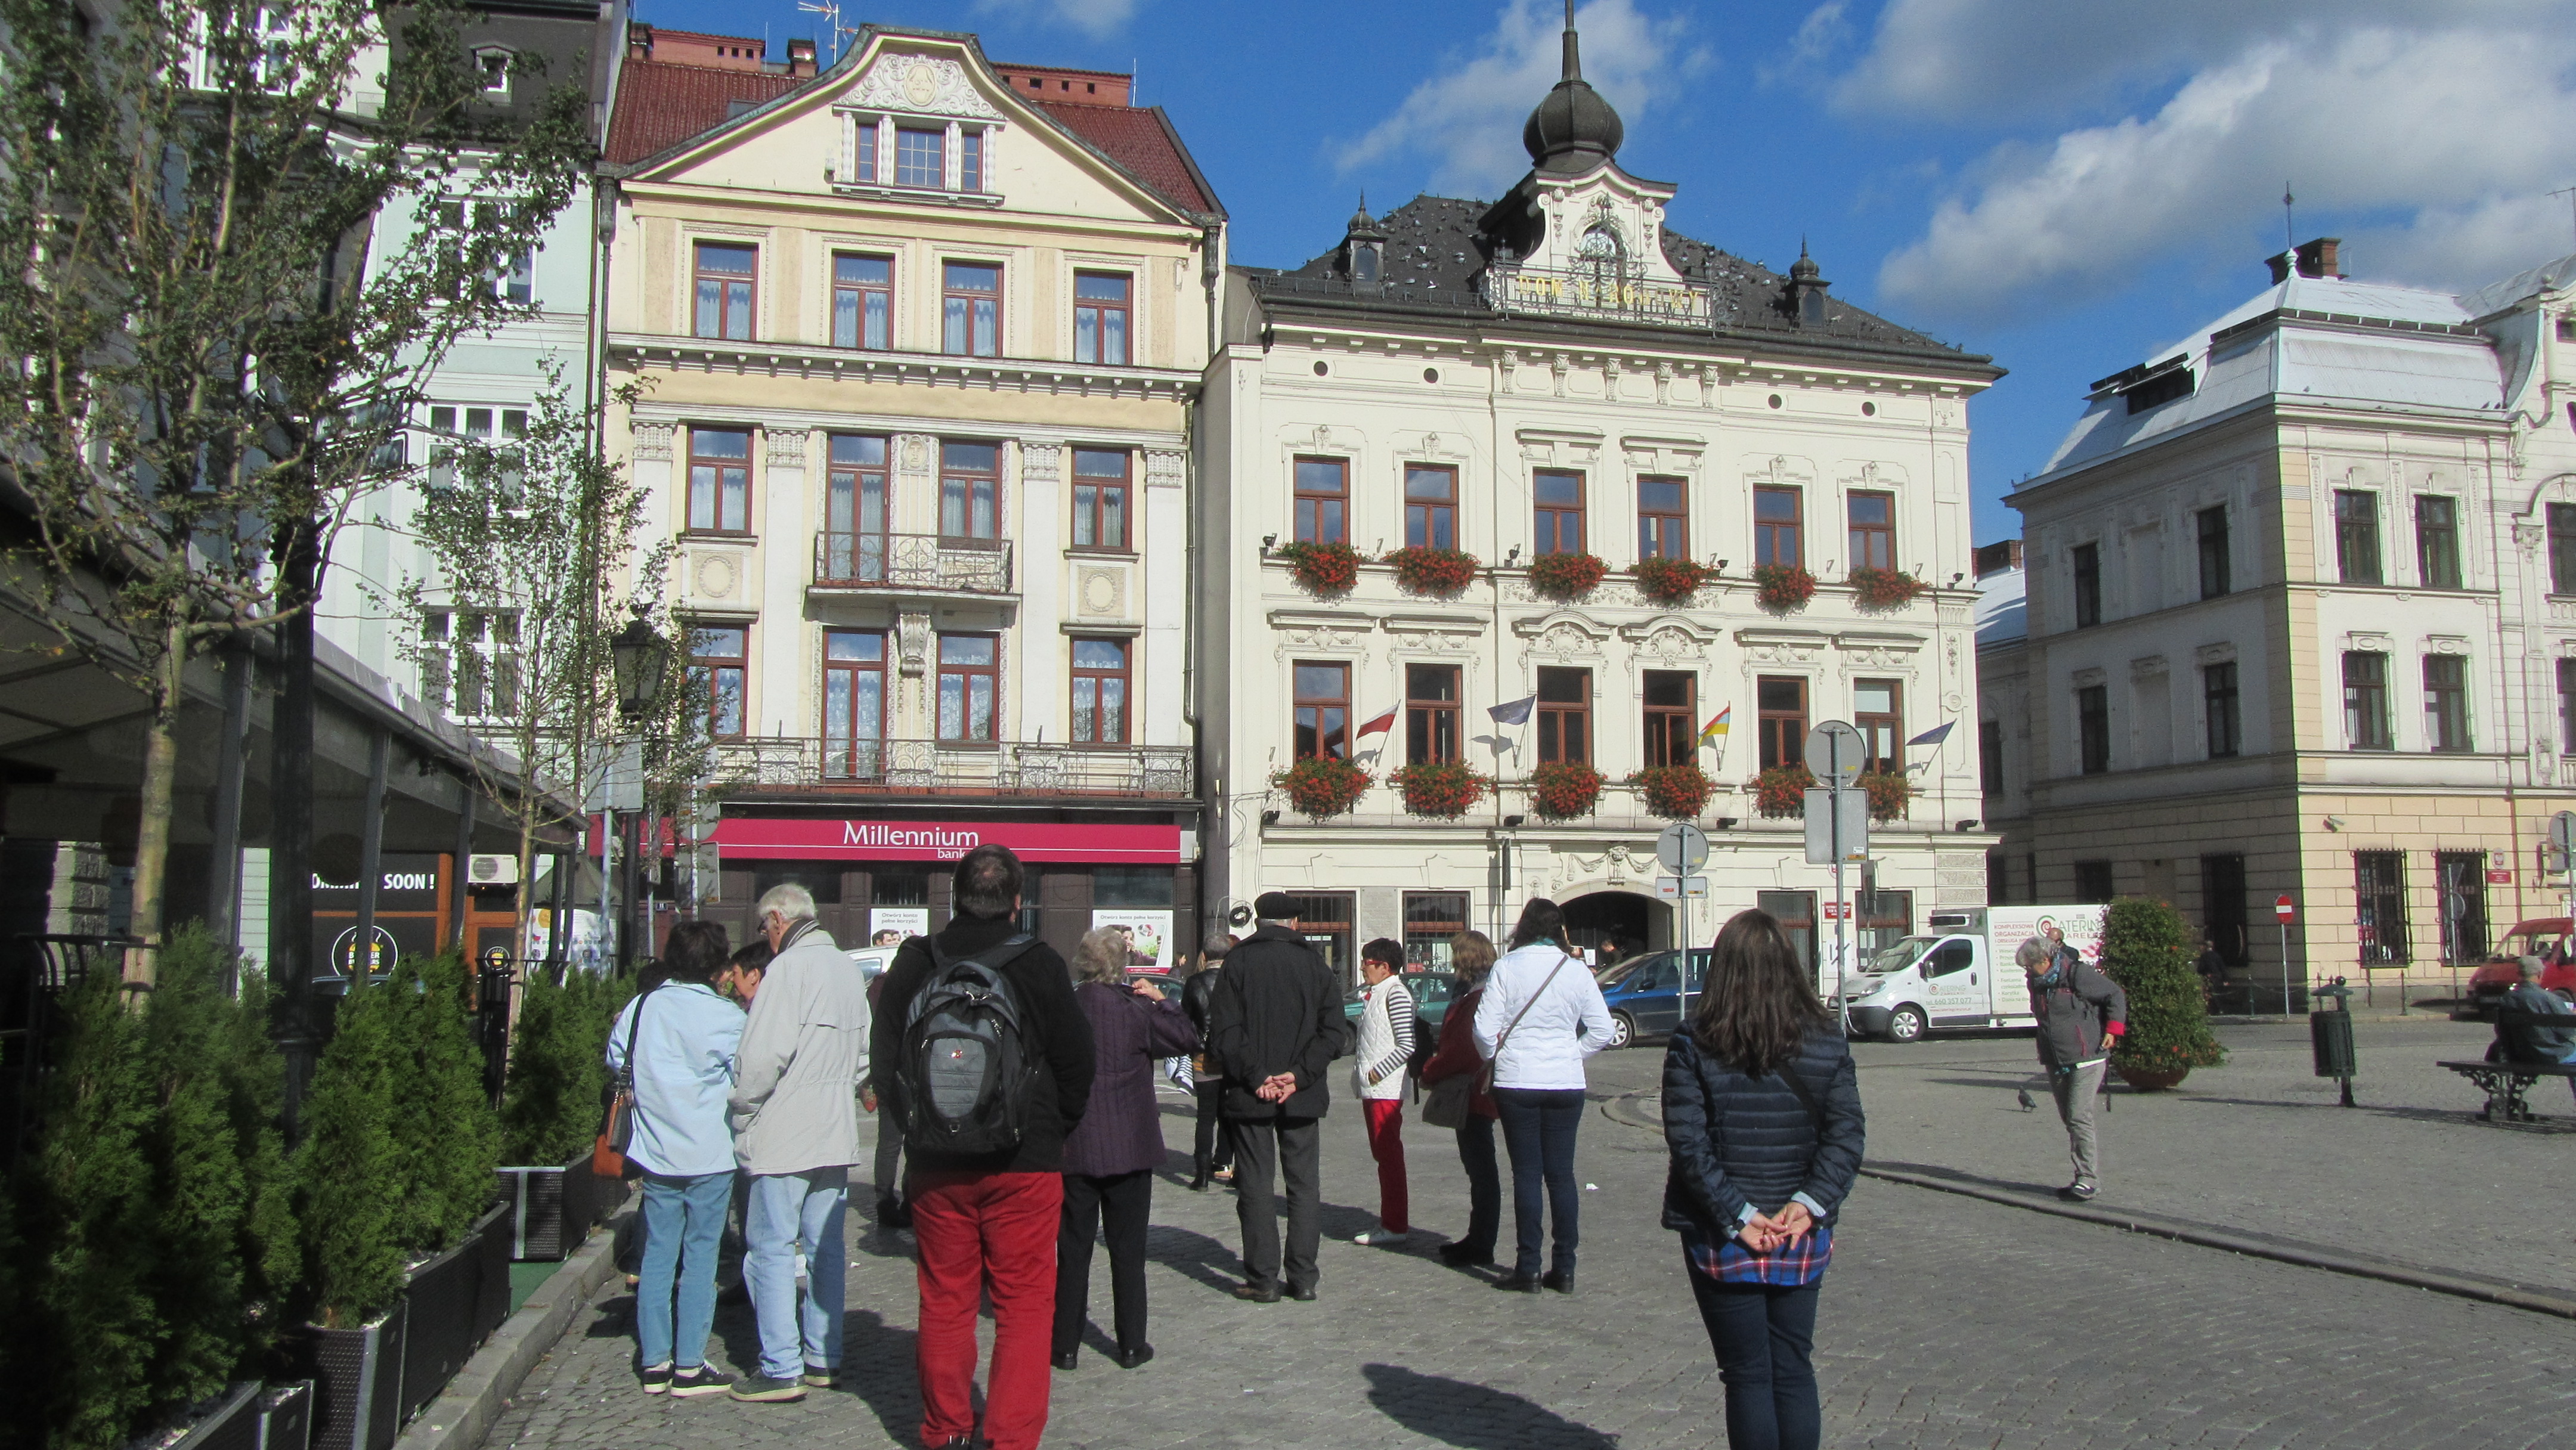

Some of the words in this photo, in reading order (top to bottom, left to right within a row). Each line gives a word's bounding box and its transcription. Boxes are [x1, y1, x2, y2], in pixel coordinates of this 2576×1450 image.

[1519, 275, 1563, 298] DOM
[843, 820, 979, 846] Millennium
[937, 848, 966, 859] bank
